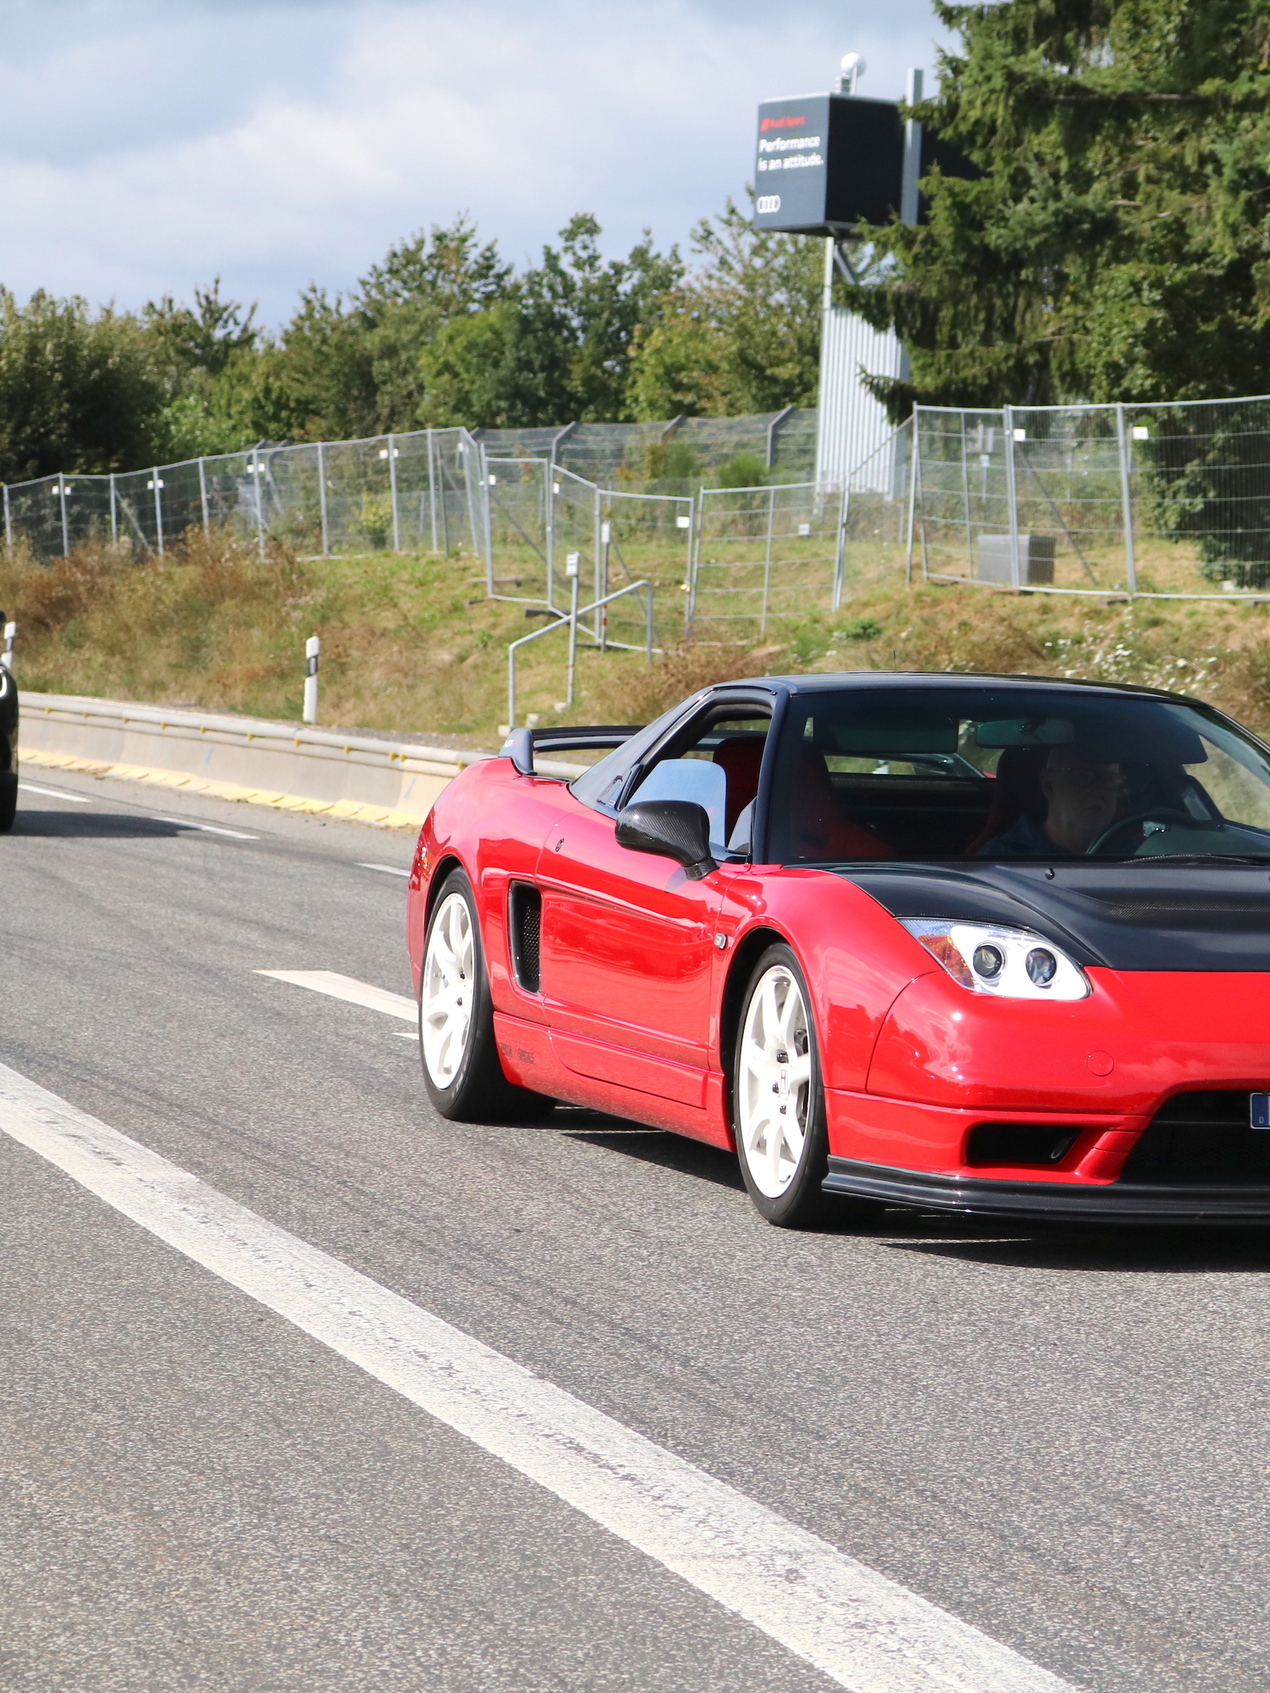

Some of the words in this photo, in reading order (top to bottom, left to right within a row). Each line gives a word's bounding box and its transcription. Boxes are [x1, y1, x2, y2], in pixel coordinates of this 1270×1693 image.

[758, 136, 821, 153] Performance
[757, 157, 768, 171] is
[768, 158, 782, 170] an
[782, 152, 824, 169] attitude.
